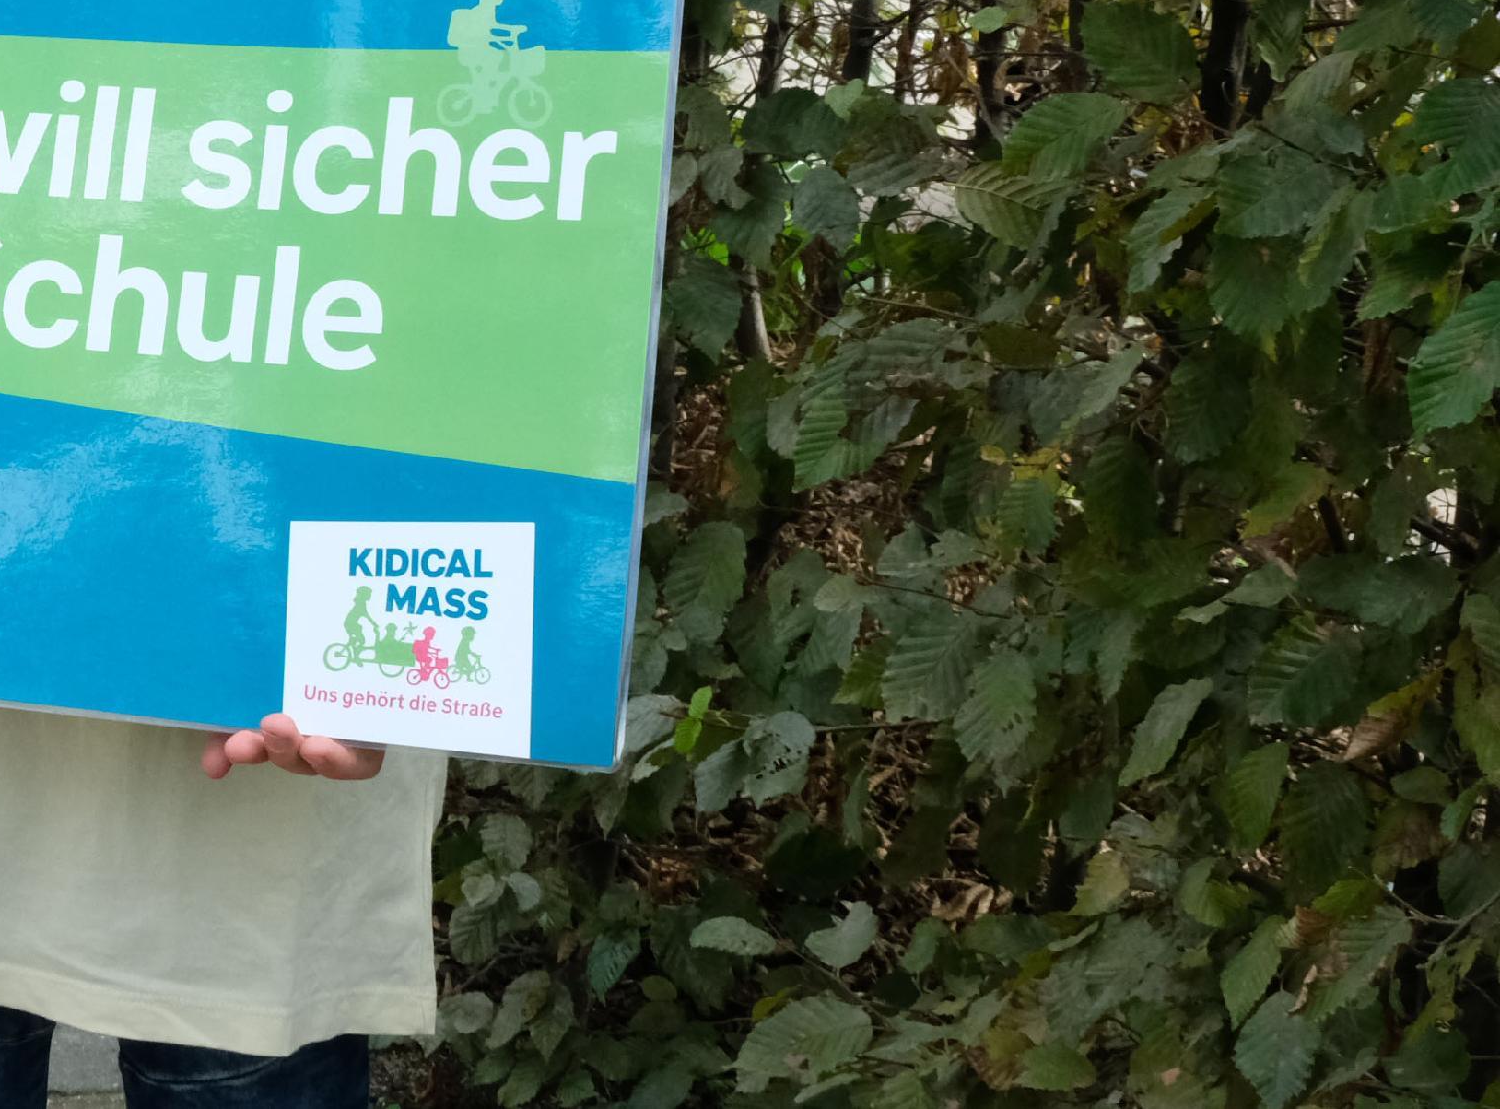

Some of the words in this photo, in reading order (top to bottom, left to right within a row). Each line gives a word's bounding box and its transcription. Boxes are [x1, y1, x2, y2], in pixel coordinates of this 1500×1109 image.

[181, 90, 618, 221] sicher
[348, 548, 494, 578] KIDICAL
[385, 583, 489, 621] MASS
[304, 685, 337, 703] Uns
[342, 691, 405, 709] gehört
[409, 695, 437, 713] die
[441, 698, 504, 719] Straße
